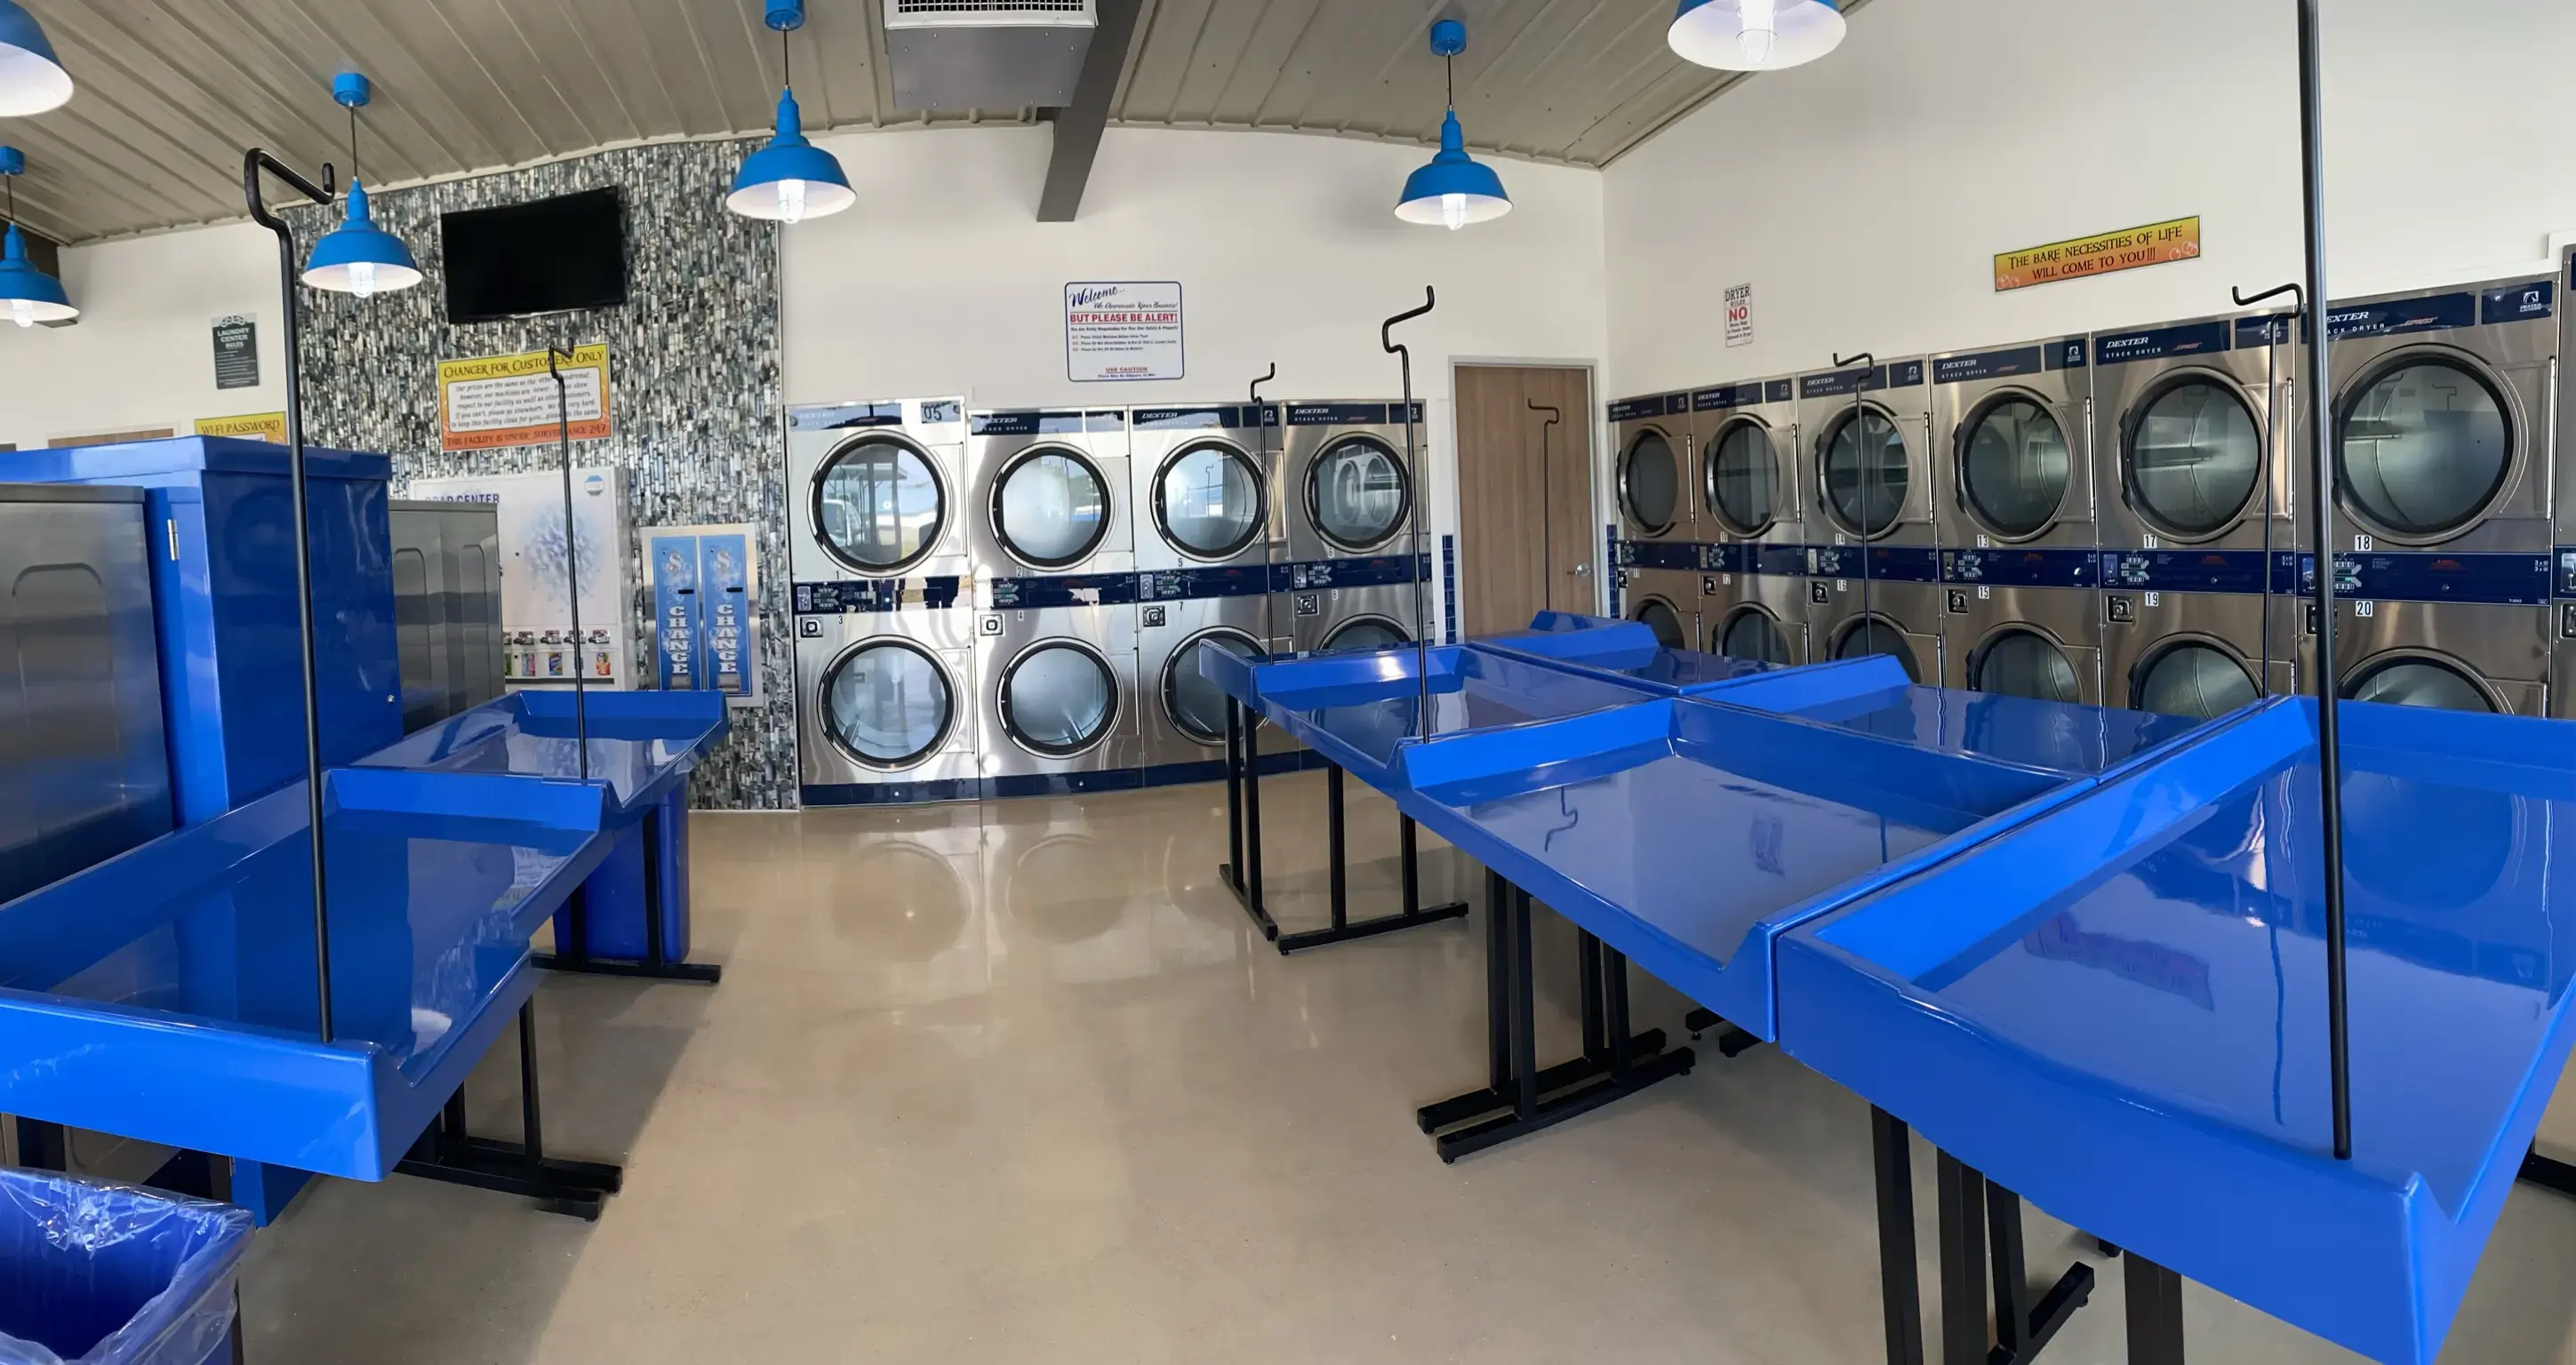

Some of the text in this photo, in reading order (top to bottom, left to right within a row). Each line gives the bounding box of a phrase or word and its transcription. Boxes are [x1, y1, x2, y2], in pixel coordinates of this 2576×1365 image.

[2008, 224, 2183, 269] THE BARE NECESSITIES OF LIFE
[2032, 247, 2156, 280] WILL COME TO YOU!!!
[1725, 285, 1749, 301] DRYER
[1070, 314, 1090, 323] BUT
[1092, 314, 1128, 323] PLEASE
[1145, 313, 1178, 322] ALERT!
[1729, 307, 1747, 322] NO
[2326, 311, 2370, 323] EXTER
[217, 328, 250, 337] LAUNDRY
[2352, 323, 2386, 332] DRYER
[220, 334, 249, 343] CENTER
[2106, 337, 2149, 349] DEXTER
[2106, 350, 2131, 359] STACK
[444, 350, 604, 379] CHANGER FOR CUSTOERS ONLY
[1941, 359, 1978, 370] DEXTER
[1806, 377, 1835, 386] DEXTER
[226, 419, 281, 433] PASSWORD
[447, 435, 463, 446] THIS
[464, 434, 492, 447] FACILITY
[495, 434, 503, 443] IS
[505, 432, 530, 442] UNDER
[1978, 535, 1988, 547] 13
[2145, 535, 2156, 547] 17
[2356, 536, 2371, 551] 18
[1178, 558, 1183, 567] 5
[836, 571, 840, 579] 1
[1017, 567, 1021, 577] 2
[1979, 587, 1989, 598] 15
[2147, 593, 2158, 605] 19
[1180, 602, 1184, 611] 7
[2356, 602, 2372, 616] 20
[838, 616, 844, 625] 3
[668, 606, 689, 674] CHANGE
[716, 604, 738, 673] CHANGE
